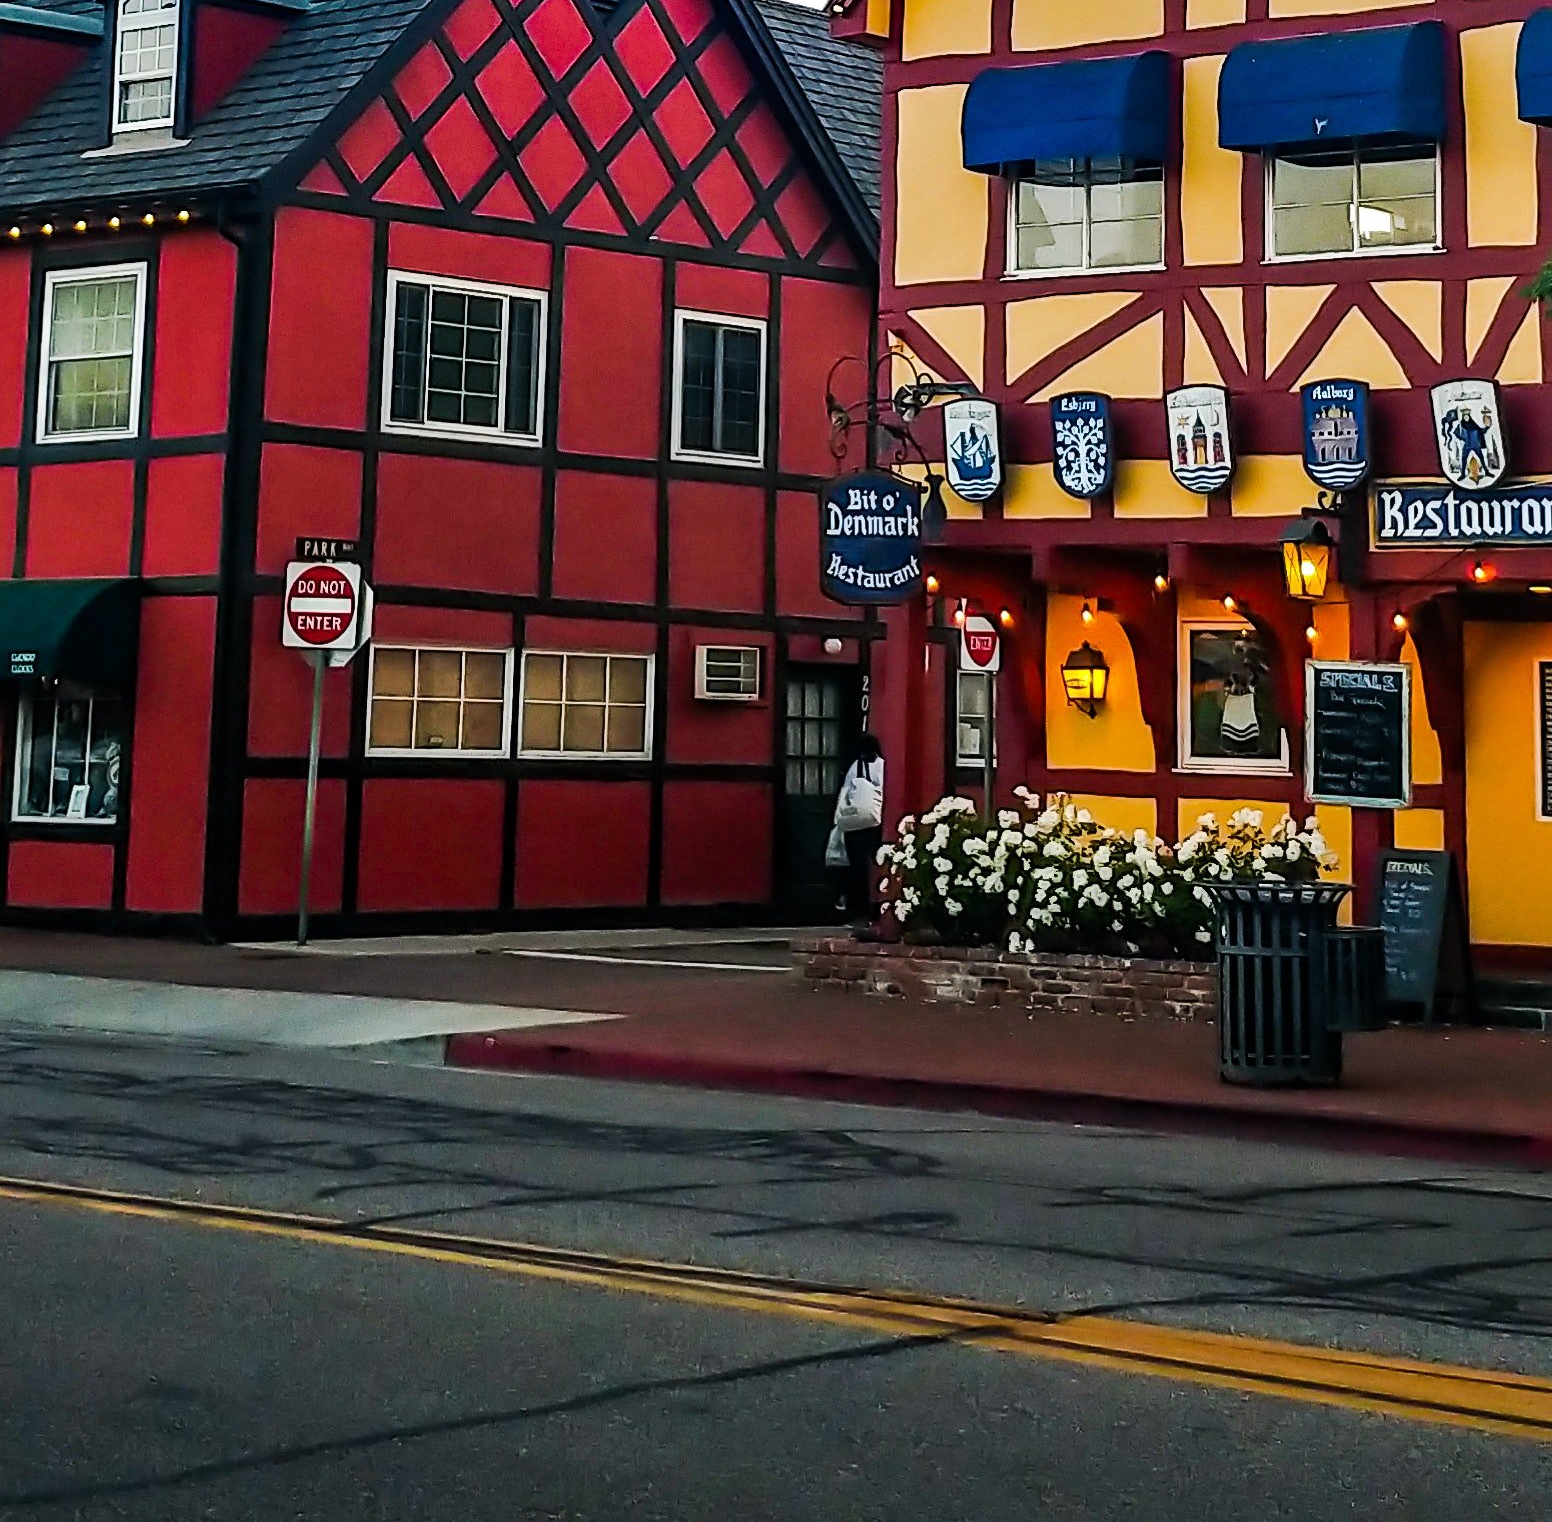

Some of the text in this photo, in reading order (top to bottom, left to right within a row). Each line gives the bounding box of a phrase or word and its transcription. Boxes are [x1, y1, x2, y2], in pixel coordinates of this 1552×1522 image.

[846, 488, 900, 511] Bit o'
[826, 501, 919, 537] Denmark
[304, 540, 337, 557] PARK
[826, 553, 920, 588] Restaurant
[298, 580, 346, 595] DO NOT
[297, 615, 342, 631] ENTER
[1320, 671, 1399, 692] SPECIALS
